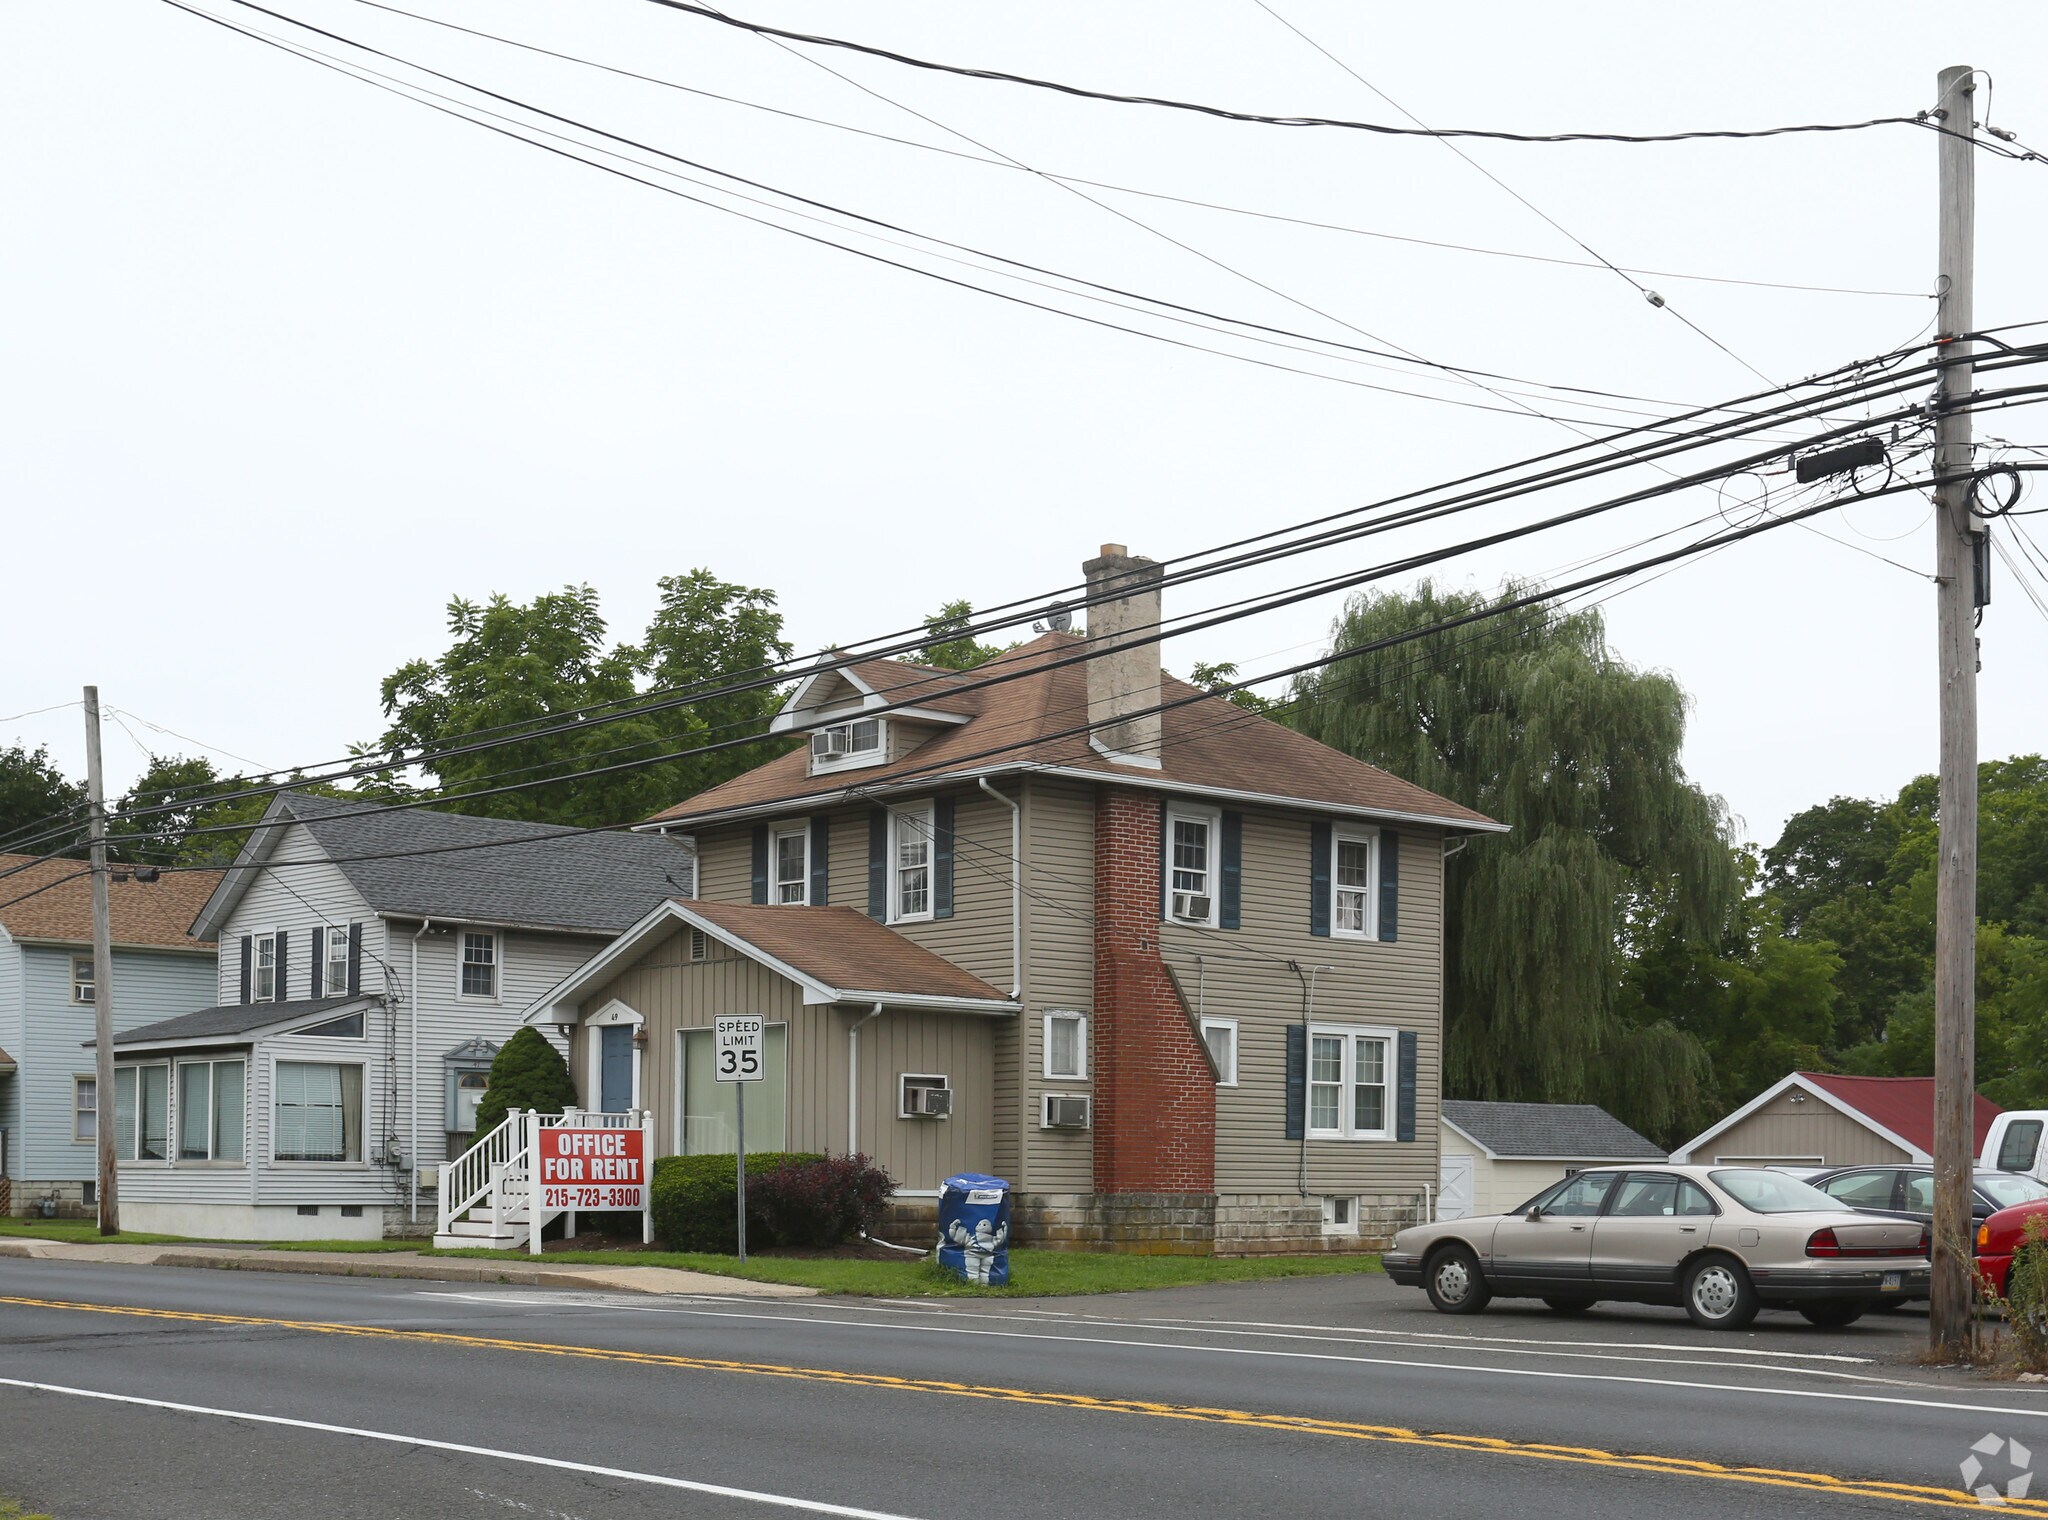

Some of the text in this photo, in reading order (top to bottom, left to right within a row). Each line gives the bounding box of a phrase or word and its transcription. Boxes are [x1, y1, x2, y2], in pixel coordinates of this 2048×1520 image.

[718, 1022, 760, 1033] SPEED
[723, 1035, 755, 1046] LIMIT
[720, 1050, 759, 1074] 35
[557, 1133, 627, 1156] OFFICE
[544, 1158, 639, 1180] FOR RENT
[545, 1188, 640, 1207] 215-723-3300
